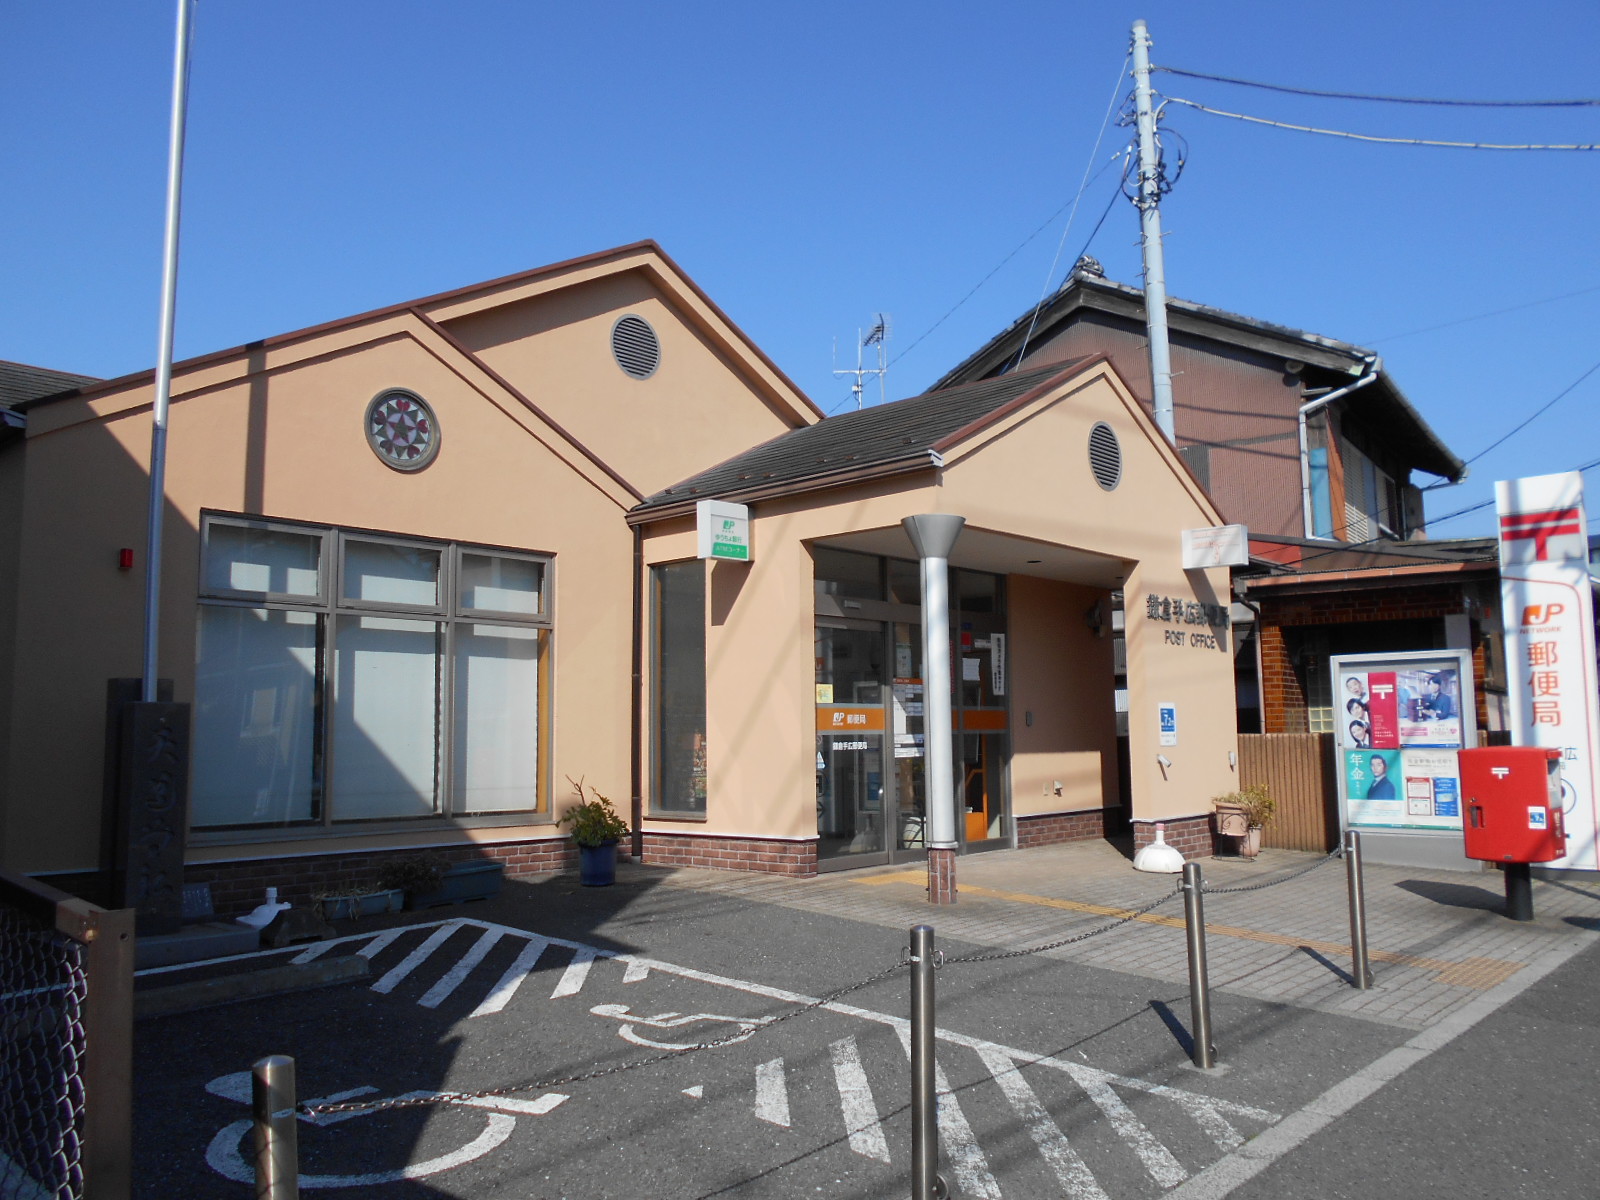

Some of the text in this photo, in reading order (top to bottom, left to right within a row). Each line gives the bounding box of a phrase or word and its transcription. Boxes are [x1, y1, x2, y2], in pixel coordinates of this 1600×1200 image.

[1164, 630, 1215, 649] POST OFFICE
[1519, 626, 1562, 635] NETWORK
[1527, 641, 1561, 727] 郵便局
[1350, 753, 1364, 780] 年金
